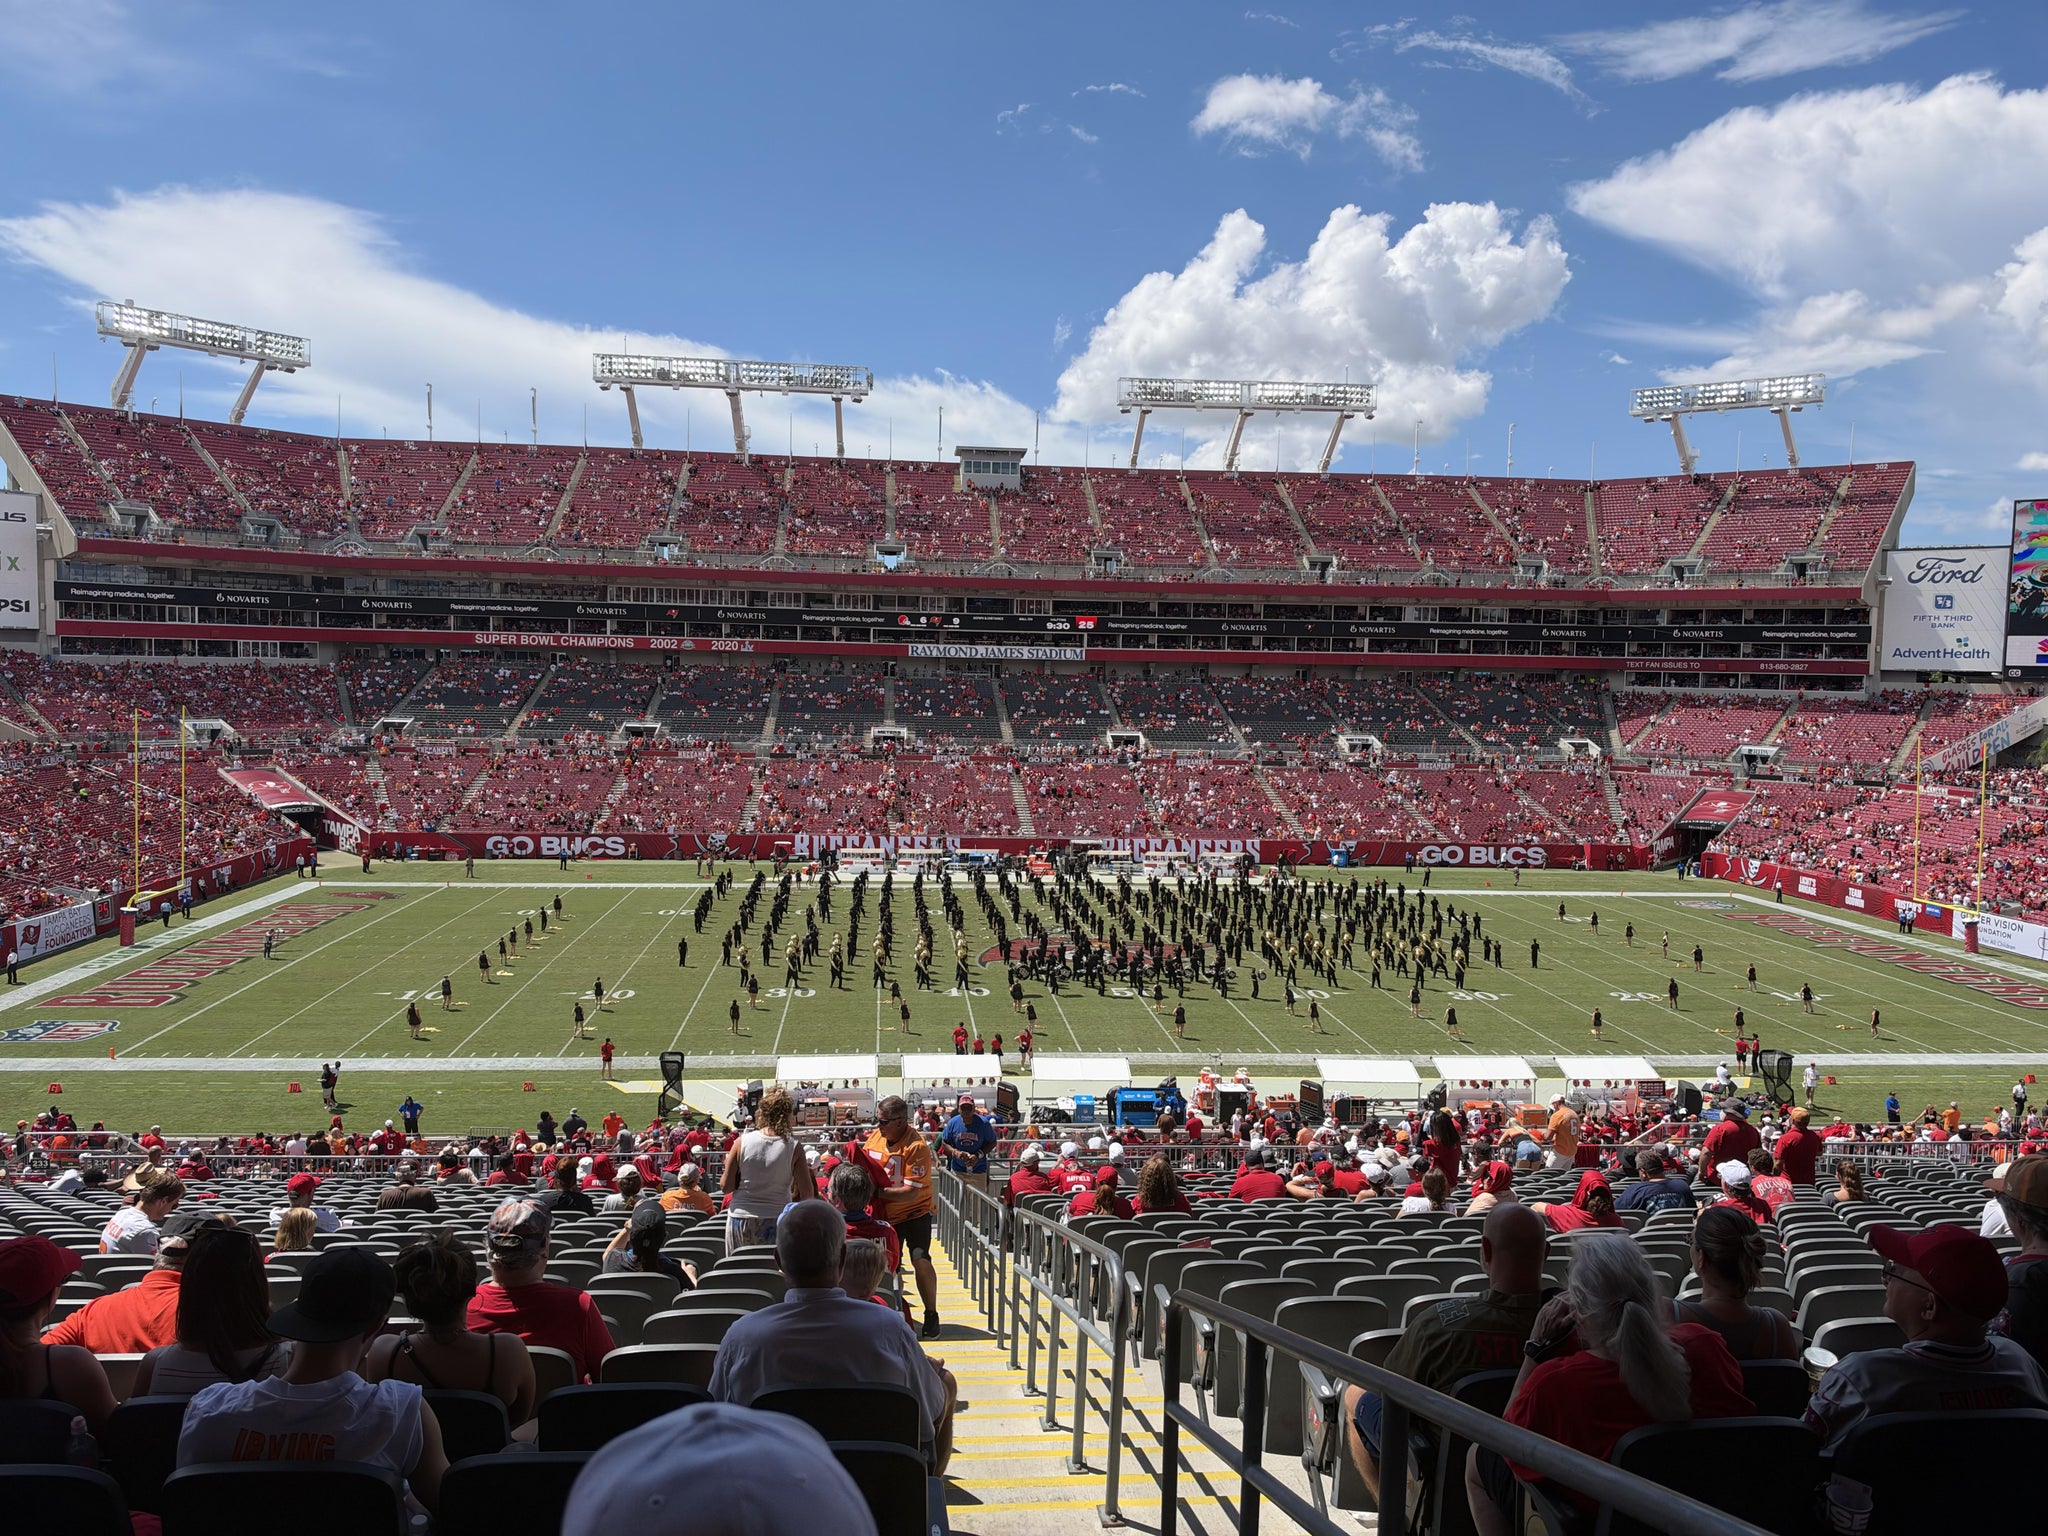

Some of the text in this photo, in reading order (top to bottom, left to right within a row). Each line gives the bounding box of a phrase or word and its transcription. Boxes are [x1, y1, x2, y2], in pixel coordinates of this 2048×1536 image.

[1907, 557, 1986, 584] Ford
[70, 588, 113, 598] Reimagining
[226, 595, 270, 604] NOVARTIS
[371, 600, 413, 609] NOVARTIS
[450, 604, 485, 612] Reimagining
[586, 607, 627, 615] NOVARTIS
[727, 611, 766, 619] NOVARTIS
[802, 614, 835, 622] Reimagining
[1078, 621, 1094, 629] 25
[1107, 621, 1139, 629] Reimagining
[1230, 624, 1267, 632] NOVARTIS
[1358, 626, 1396, 634] NOVARTIS
[1682, 630, 1723, 638] NOVARTIS
[1762, 630, 1799, 638] Reimagining
[475, 634, 634, 648] SUPER BOWL CHAMPIONS
[650, 639, 678, 649] 2002
[711, 640, 739, 651] 2020
[910, 646, 1085, 659] RAYMOND JAMES STADIUM
[1892, 647, 1990, 659] AdventHealth
[1942, 736, 1977, 763] GLASSES
[1979, 728, 1993, 743] FOR
[322, 819, 361, 843] TAMPA
[486, 835, 625, 856] GO BUCS
[1652, 835, 1675, 854] TAMPA
[1421, 845, 1546, 865] GO BUCS
[1849, 887, 1862, 899] TEAM
[43, 907, 82, 926] TAMPA BAY
[98, 902, 110, 919] 25
[44, 914, 91, 938] BUCCANEERS
[1994, 919, 2024, 933] VISION
[45, 925, 93, 950] FOUNDATION
[1997, 940, 2016, 950] Children
[764, 987, 817, 999] 30
[943, 987, 991, 999] 40
[1446, 990, 1501, 1002] 30
[523, 1082, 534, 1091] 20
[1570, 1119, 1577, 1135] 6
[32, 1159, 49, 1167] 233
[912, 1165, 926, 1177] 54
[673, 1202, 695, 1211] EVANS
[231, 1428, 336, 1461] IRVING
